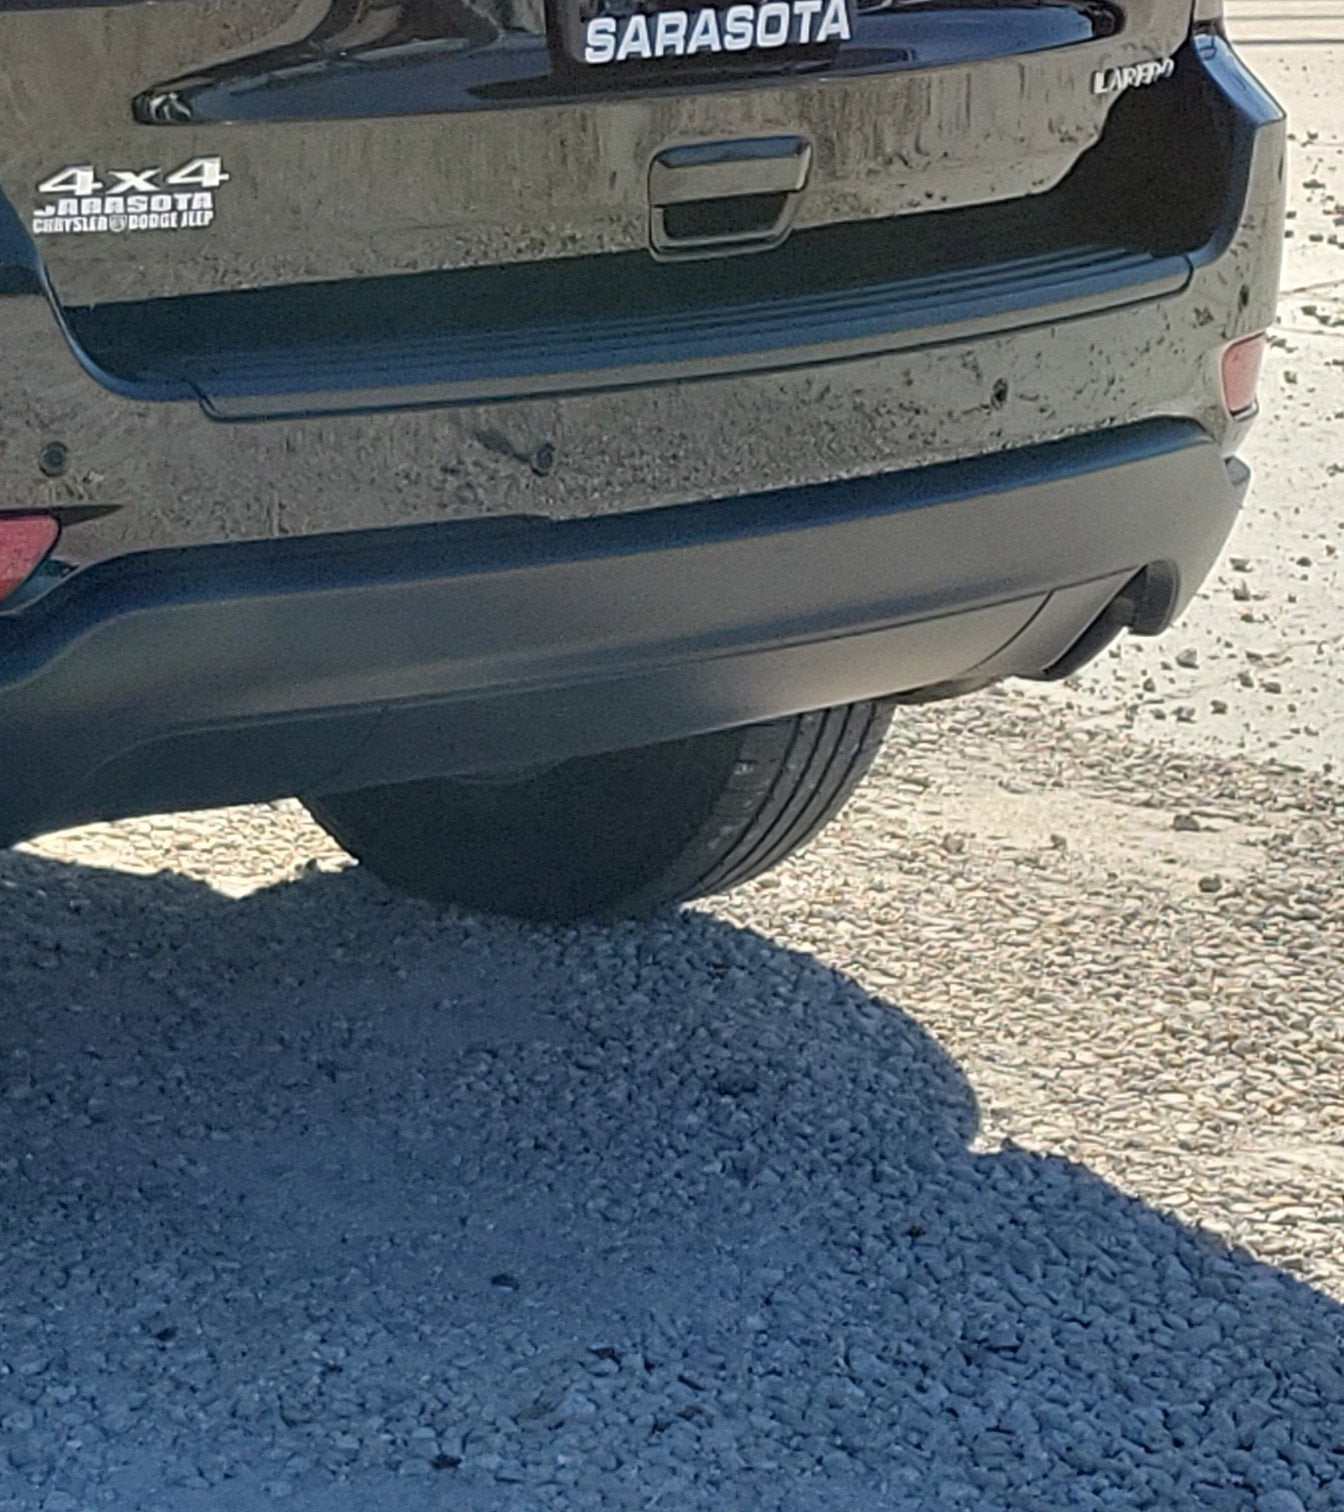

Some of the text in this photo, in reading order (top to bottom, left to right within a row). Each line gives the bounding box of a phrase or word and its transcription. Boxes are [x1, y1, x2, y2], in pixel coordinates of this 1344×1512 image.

[38, 156, 230, 195] 4x4
[128, 212, 178, 231] DODGE
[180, 210, 214, 227] JEEP
